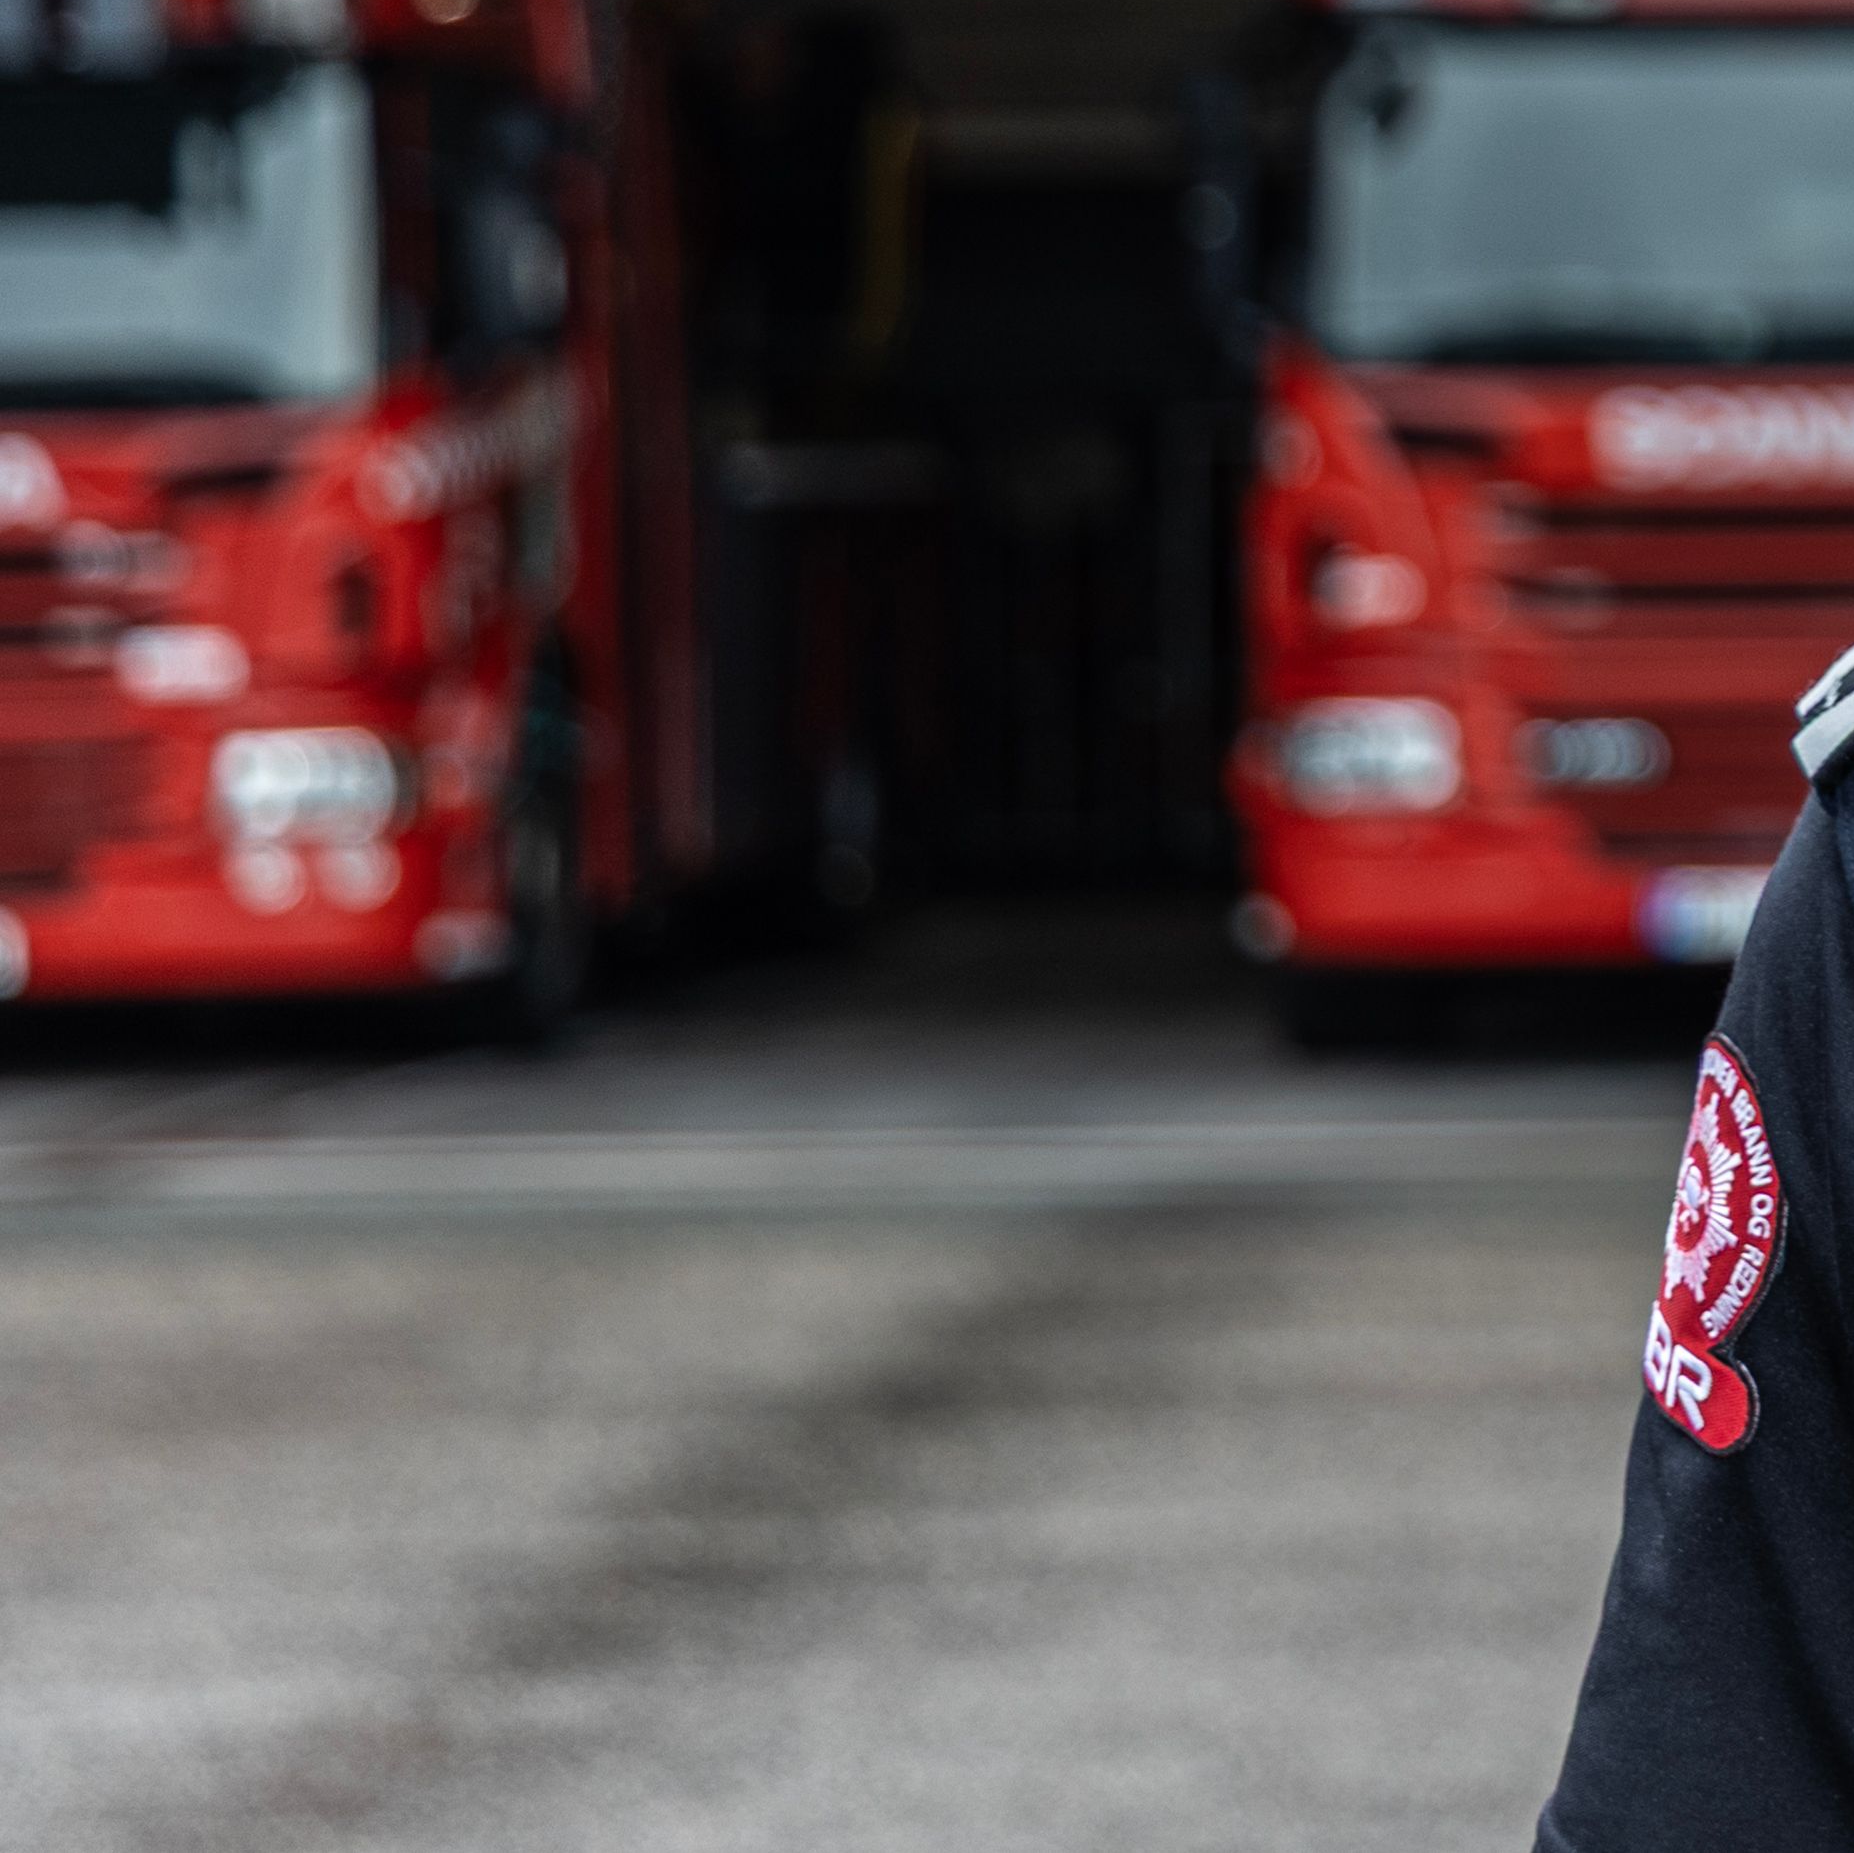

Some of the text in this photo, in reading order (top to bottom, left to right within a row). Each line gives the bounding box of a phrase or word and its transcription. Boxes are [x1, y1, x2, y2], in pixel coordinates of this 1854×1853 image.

[1731, 1088, 1773, 1188] BRANN
[1747, 1192, 1775, 1240] OG
[1643, 1299, 1713, 1432] BR
